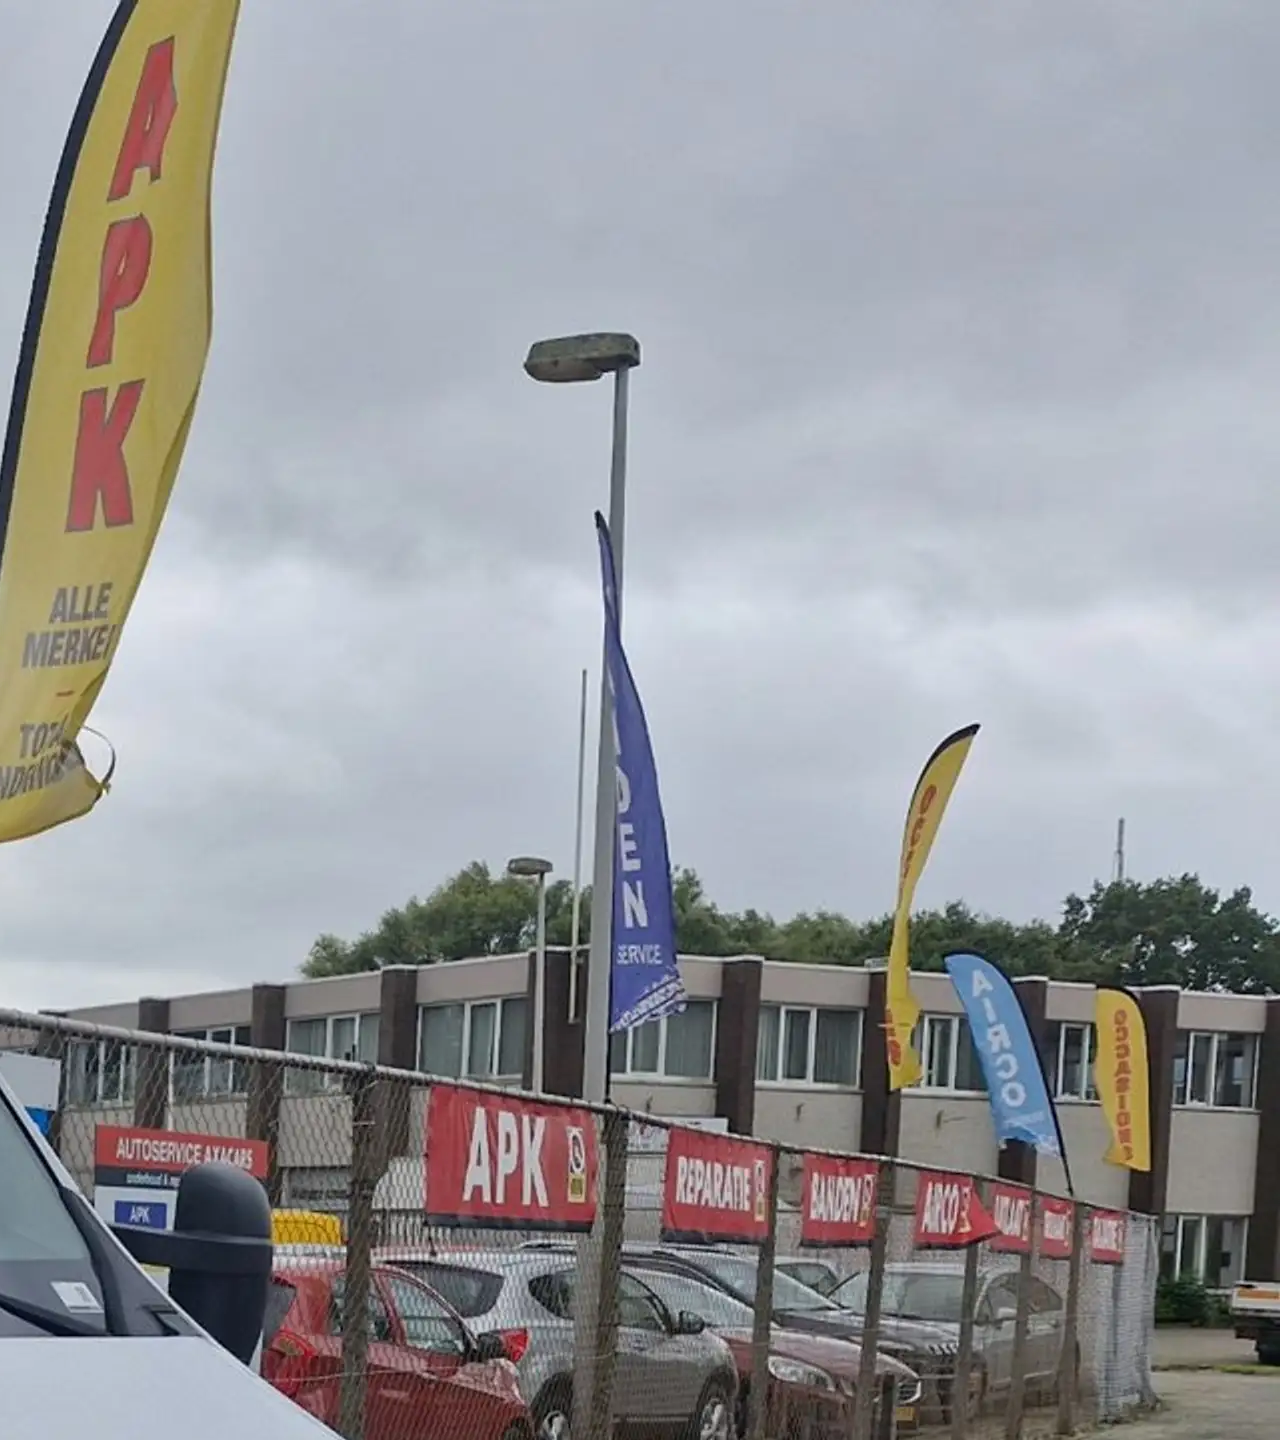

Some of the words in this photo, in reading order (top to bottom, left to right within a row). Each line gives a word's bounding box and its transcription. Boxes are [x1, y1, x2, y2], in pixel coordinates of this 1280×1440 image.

[64, 35, 178, 534] APK
[49, 582, 113, 624] ALLE
[616, 944, 663, 965] SERVICE
[116, 1137, 201, 1164] AUTOSERVICE
[462, 1106, 550, 1207] APK
[675, 1155, 752, 1212] REPARATIE
[129, 1205, 151, 1224] APK
